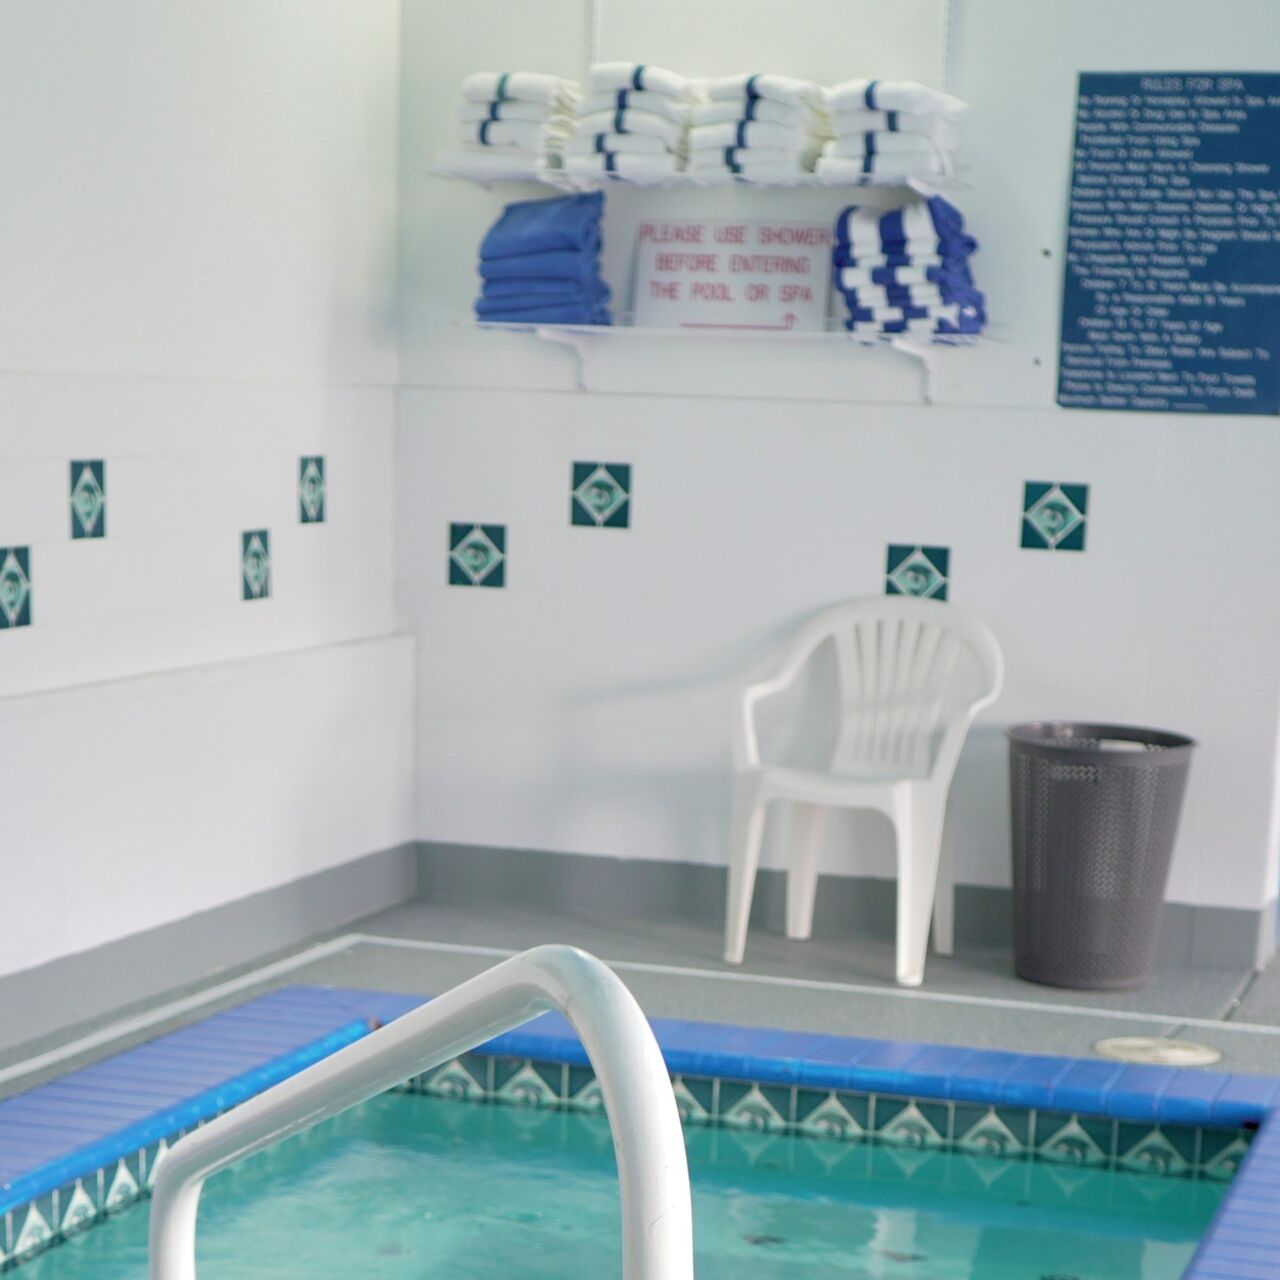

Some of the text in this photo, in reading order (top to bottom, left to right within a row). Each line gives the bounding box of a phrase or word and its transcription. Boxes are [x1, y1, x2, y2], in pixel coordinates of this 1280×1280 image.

[1140, 76, 1243, 90] RULES FOR SPA
[640, 223, 831, 245] PLEASE USE SHOWER
[655, 253, 810, 273] BEFORE ENTERING
[649, 281, 813, 302] THE POOL OR SPA
